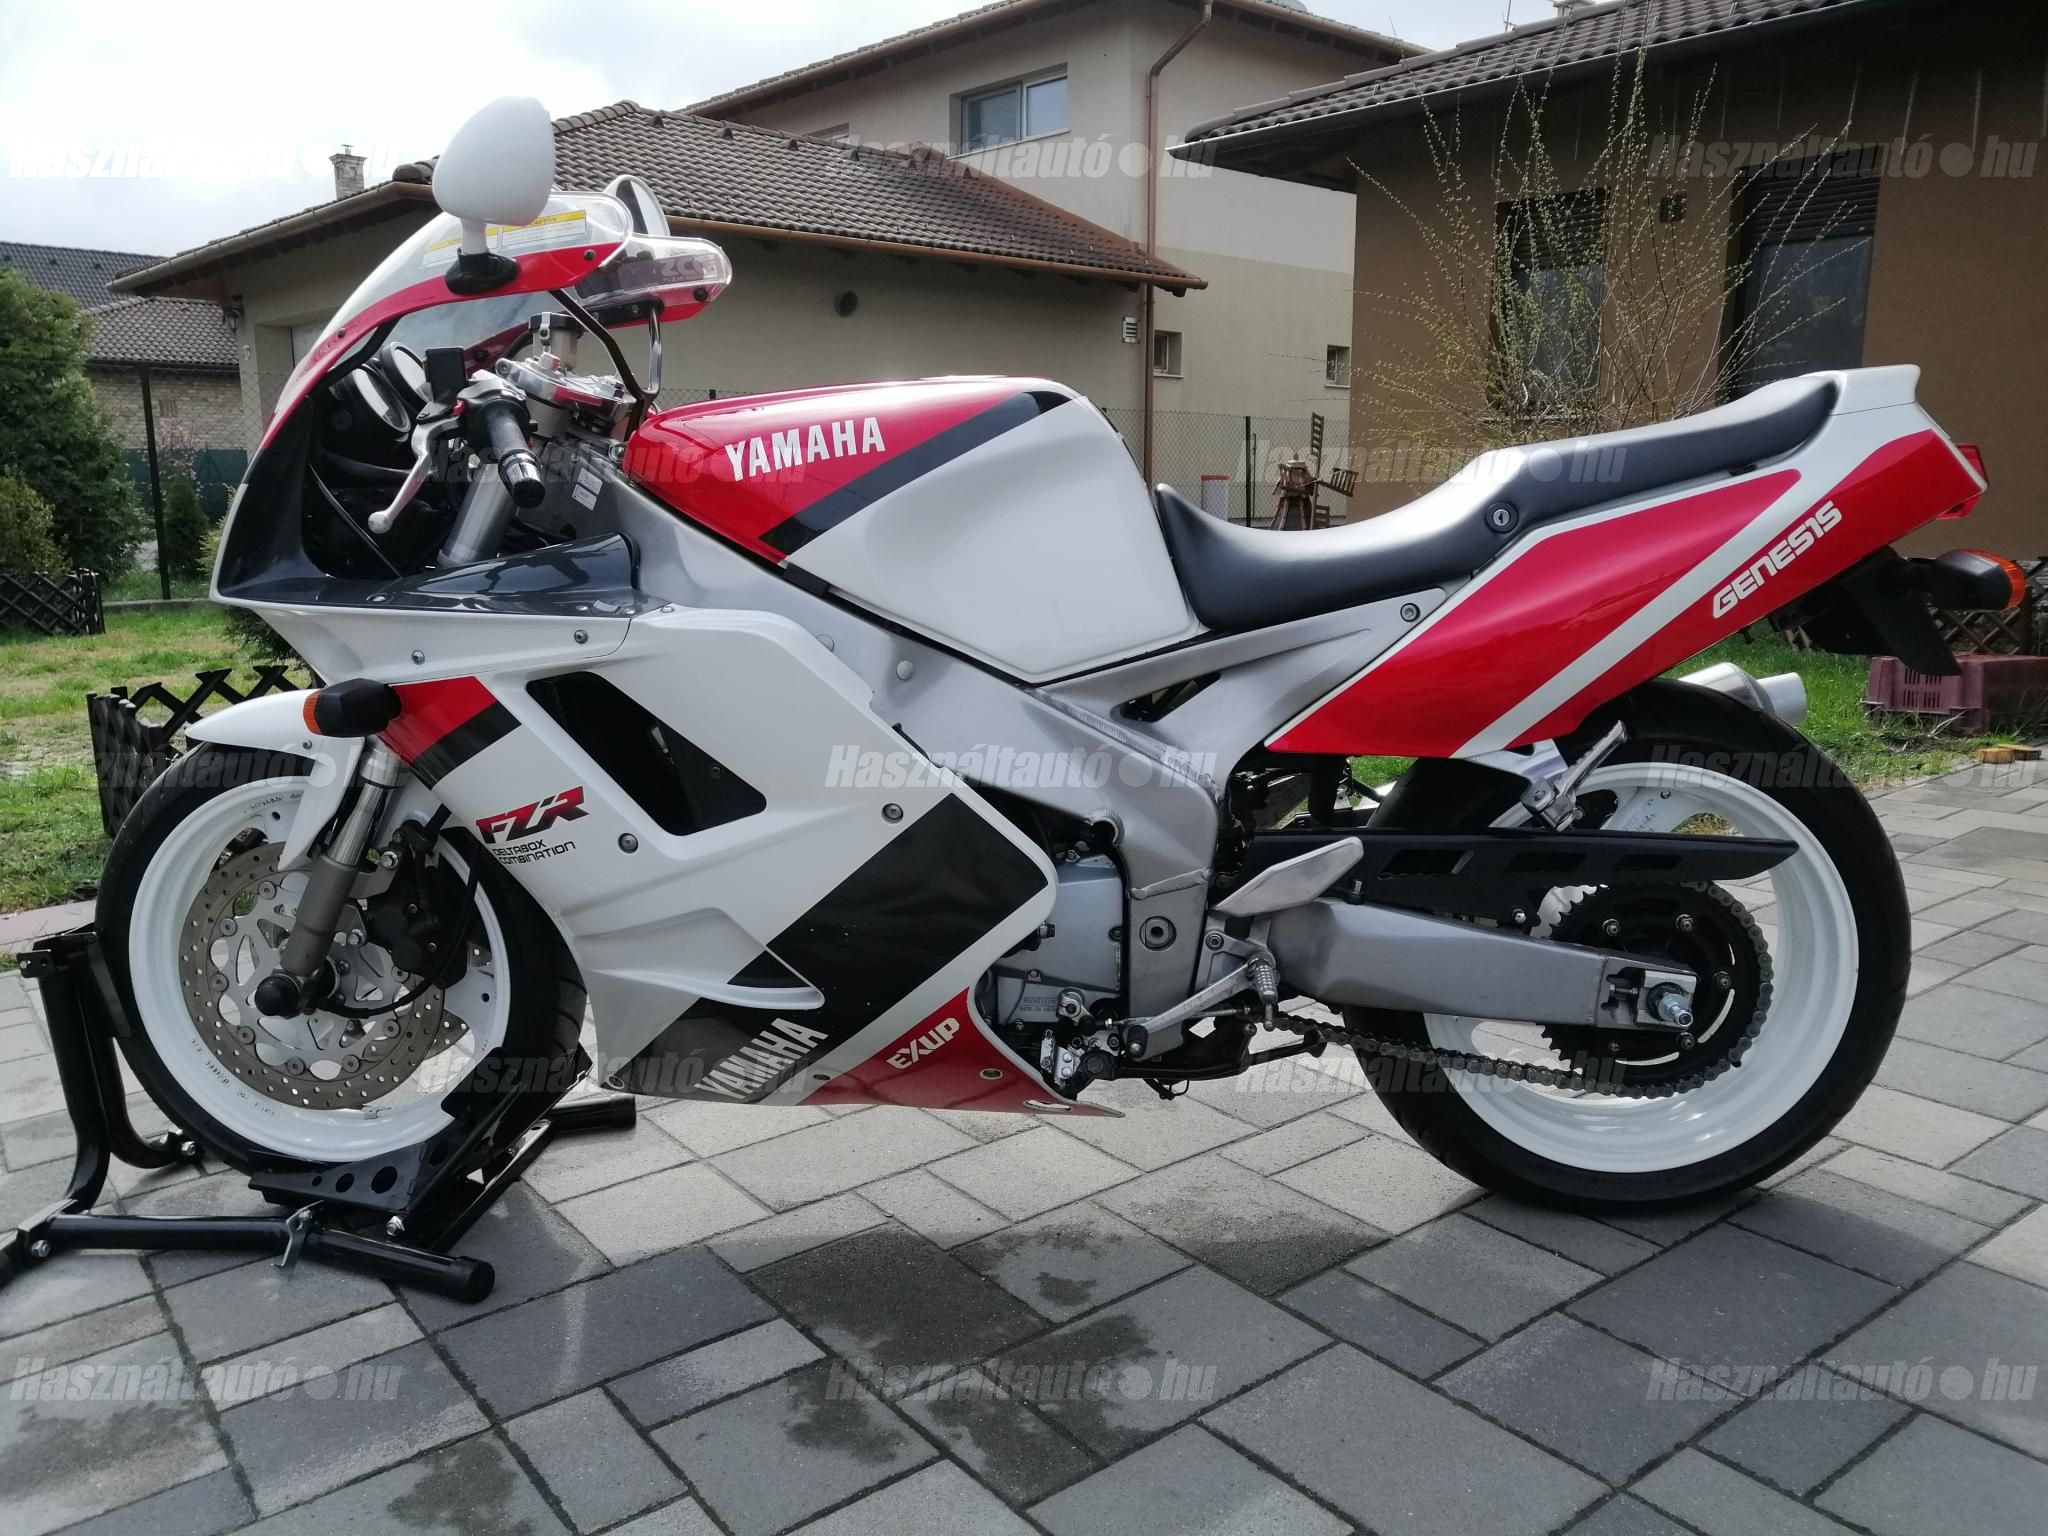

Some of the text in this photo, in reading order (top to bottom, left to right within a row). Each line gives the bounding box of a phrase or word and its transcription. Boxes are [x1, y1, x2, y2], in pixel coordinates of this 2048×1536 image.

[724, 416, 886, 482] YAMAHA
[1712, 500, 1843, 619] GENESIS
[475, 785, 590, 844] FZR
[492, 839, 547, 856] DELTABOX
[499, 840, 576, 864] COMBINATION
[693, 1017, 829, 1100] YAMAHA
[886, 1017, 960, 1070] EXUP
